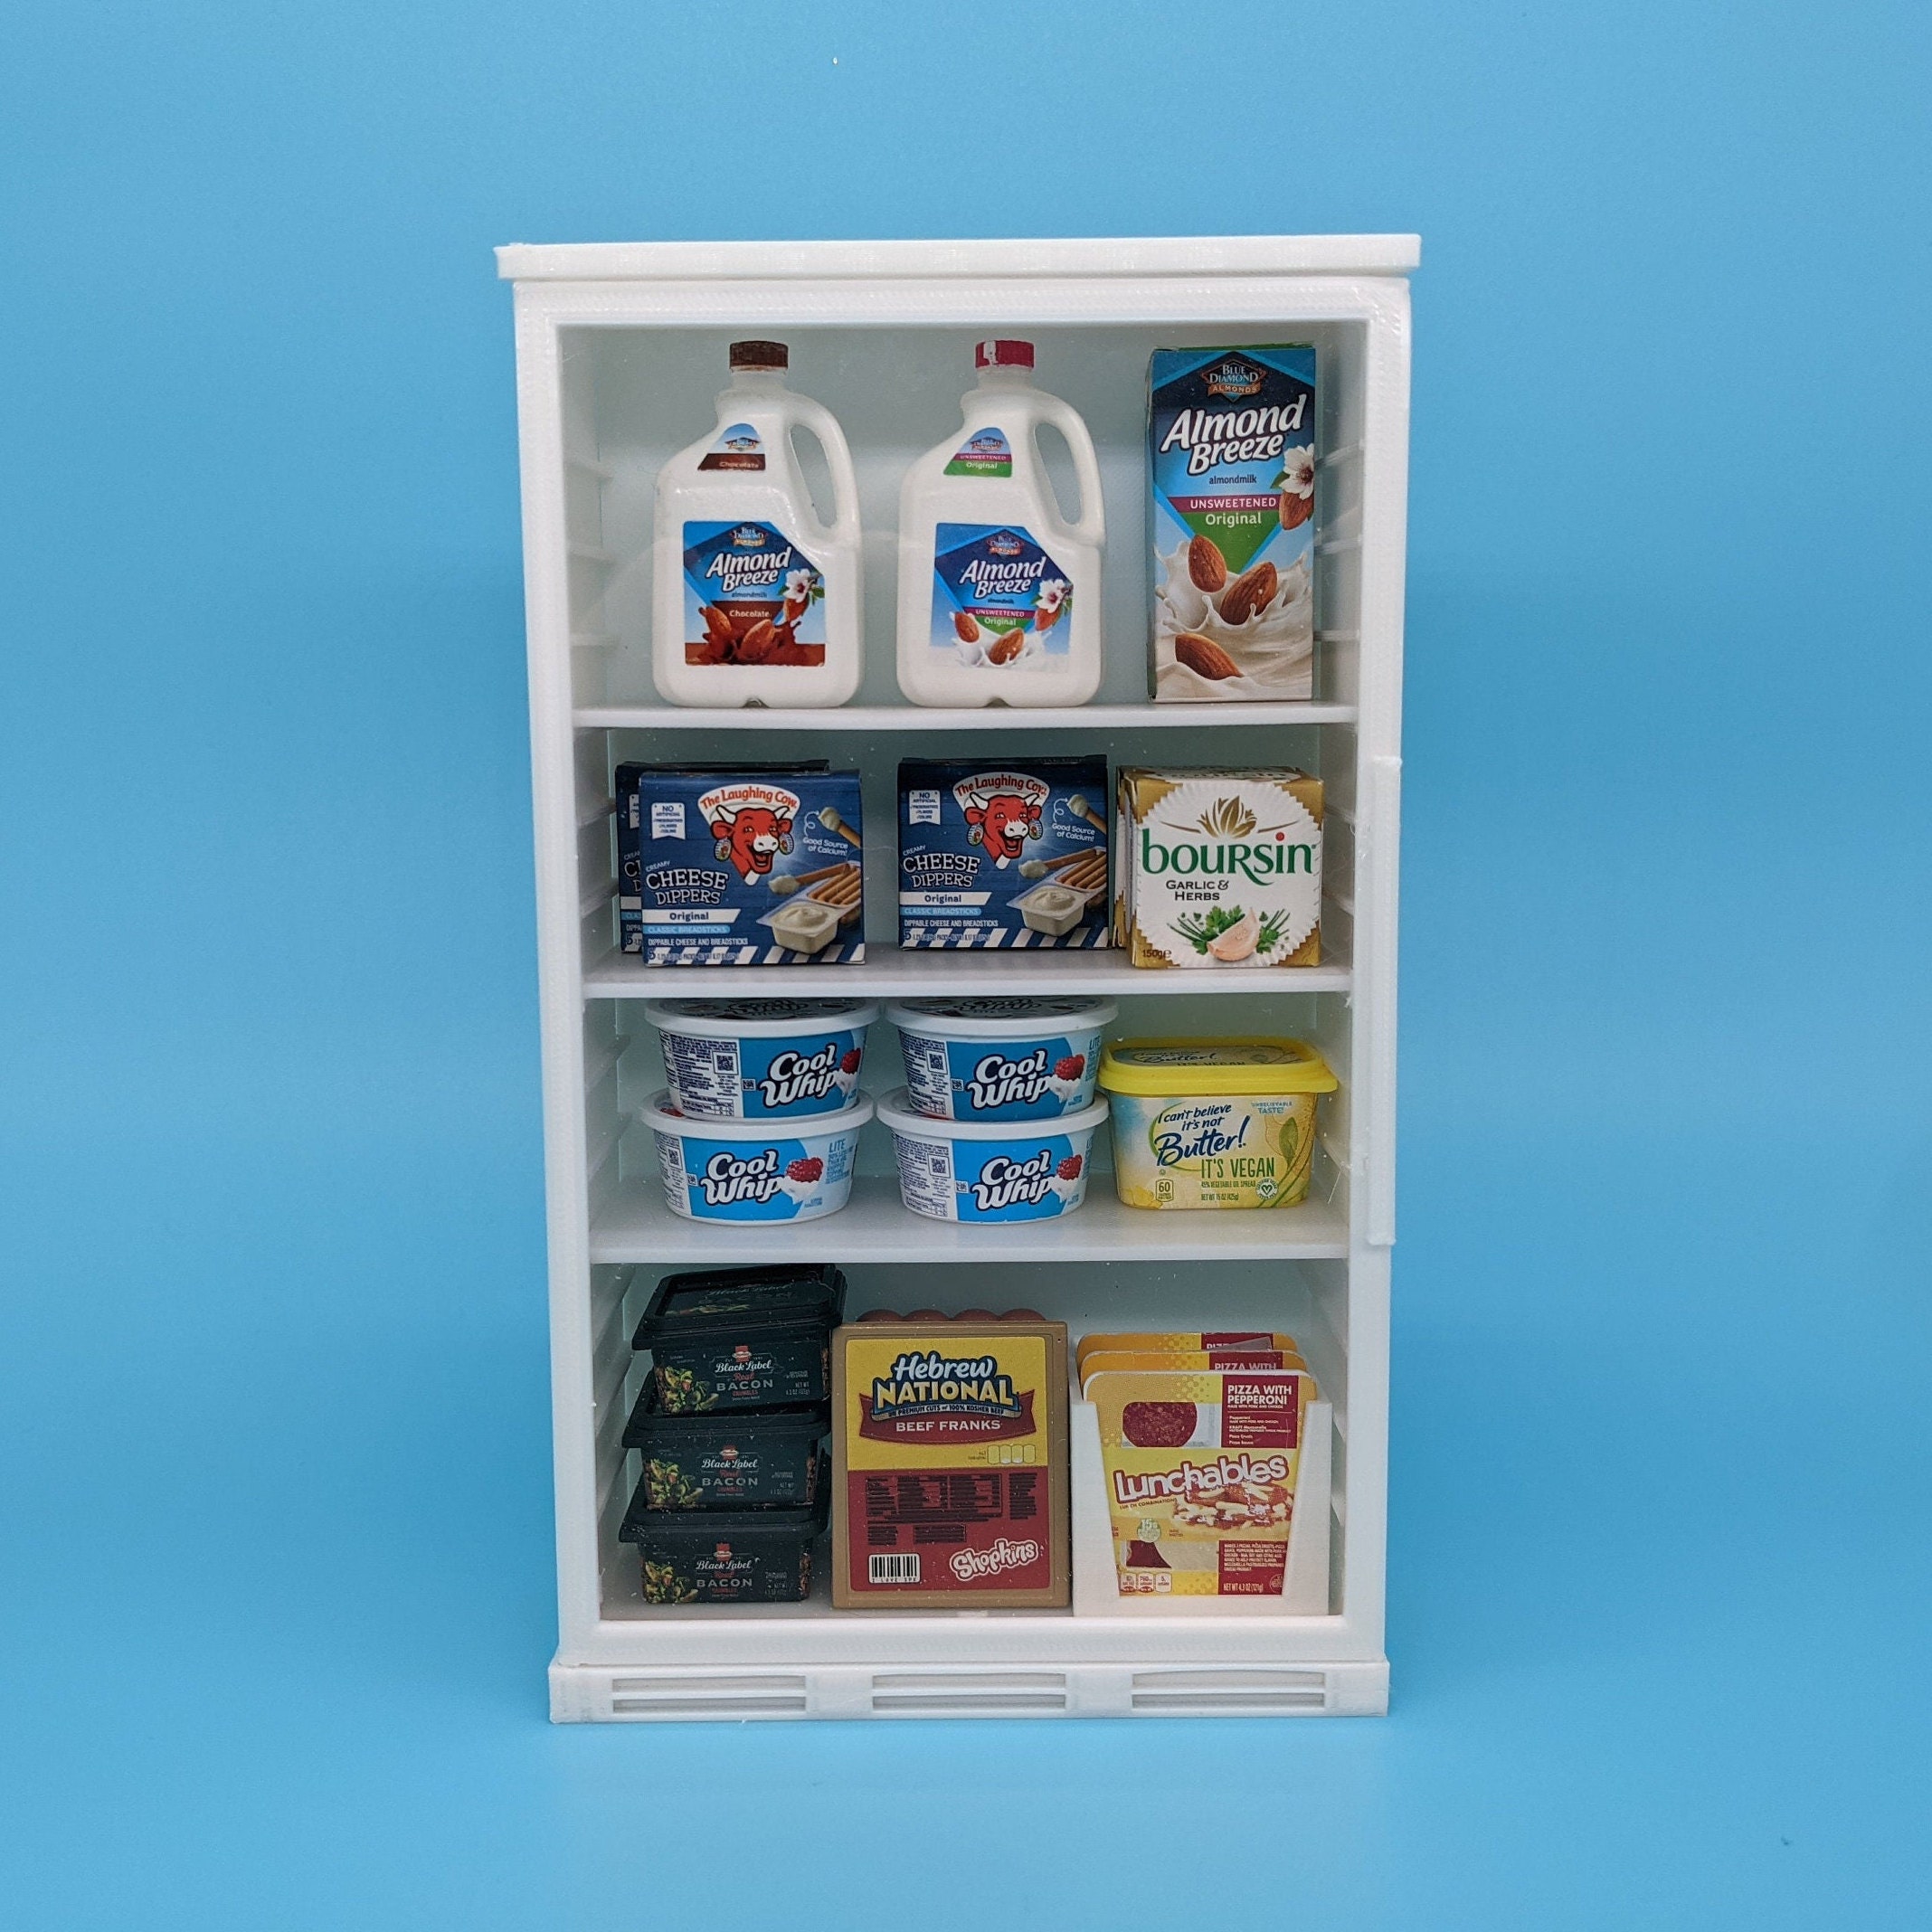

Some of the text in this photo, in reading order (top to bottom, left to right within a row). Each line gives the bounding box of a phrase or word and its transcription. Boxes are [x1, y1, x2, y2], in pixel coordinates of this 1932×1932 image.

[1222, 365, 1245, 374] BLUE
[1209, 373, 1259, 384] DIAMOND
[1160, 393, 1307, 451] Almond
[1189, 434, 1283, 475] Breeze
[1209, 474, 1256, 485] almondmilk
[1190, 497, 1276, 509] UNSWEETENED
[1206, 513, 1262, 528] Original
[706, 546, 792, 578] Almond
[959, 556, 1046, 584] Almond
[723, 569, 779, 592] Breeze
[974, 579, 1031, 598] Breeze
[729, 610, 770, 618] Chocolate
[976, 609, 1025, 617] UNSWEETENED
[984, 618, 1017, 626] Original
[954, 784, 974, 796] The
[975, 775, 1024, 792] Laughing
[700, 796, 720, 809] The
[721, 786, 773, 803] Laughing
[1052, 823, 1095, 835] Good Source
[823, 839, 848, 848] Source
[1065, 832, 1094, 842] Calcium!
[903, 845, 926, 856] CREAMY
[1141, 828, 1313, 886] boursin
[646, 861, 670, 872] CREAMY
[903, 853, 980, 874] CHEESE
[646, 869, 729, 890] CHEESE
[912, 872, 973, 887] DIPPERS
[1166, 880, 1229, 890] GARLIC &
[655, 889, 721, 905] DIPPERS
[924, 895, 961, 904] Original
[1175, 892, 1220, 901] HERBS
[669, 912, 709, 922] Original
[770, 1045, 836, 1082] Cool
[976, 1051, 1046, 1084] Cool
[760, 1068, 839, 1107] Whip
[967, 1073, 1050, 1109] Whip
[1164, 1110, 1193, 1122] can't
[1193, 1104, 1231, 1118] believe
[1182, 1116, 1225, 1132] it's not
[829, 1139, 846, 1152] LITE
[708, 1151, 778, 1180] Cool
[982, 1151, 1050, 1185] Cool
[1201, 1157, 1275, 1179] IT'S VEGAN
[701, 1174, 785, 1206] Whip
[972, 1173, 1054, 1210] Whip
[1158, 1181, 1171, 1193] 60
[715, 1359, 773, 1373] Black Label
[895, 1354, 992, 1381] Hebrew
[716, 1379, 773, 1391] BACON
[1227, 1385, 1293, 1395] PIZZA WITH
[876, 1378, 1015, 1408] NATIONAL
[1227, 1395, 1287, 1405] PEPPERONI
[898, 1406, 925, 1416] PREMIUM
[966, 1405, 990, 1413] KOSHER
[896, 1419, 1001, 1433] BEEF FRANKS
[701, 1459, 758, 1469] Black Label
[702, 1477, 758, 1486] BACON
[1115, 1455, 1288, 1502] Lunchables
[696, 1559, 752, 1570] Black Label
[952, 1540, 1037, 1578] Shopkins
[696, 1578, 753, 1587] BACON
